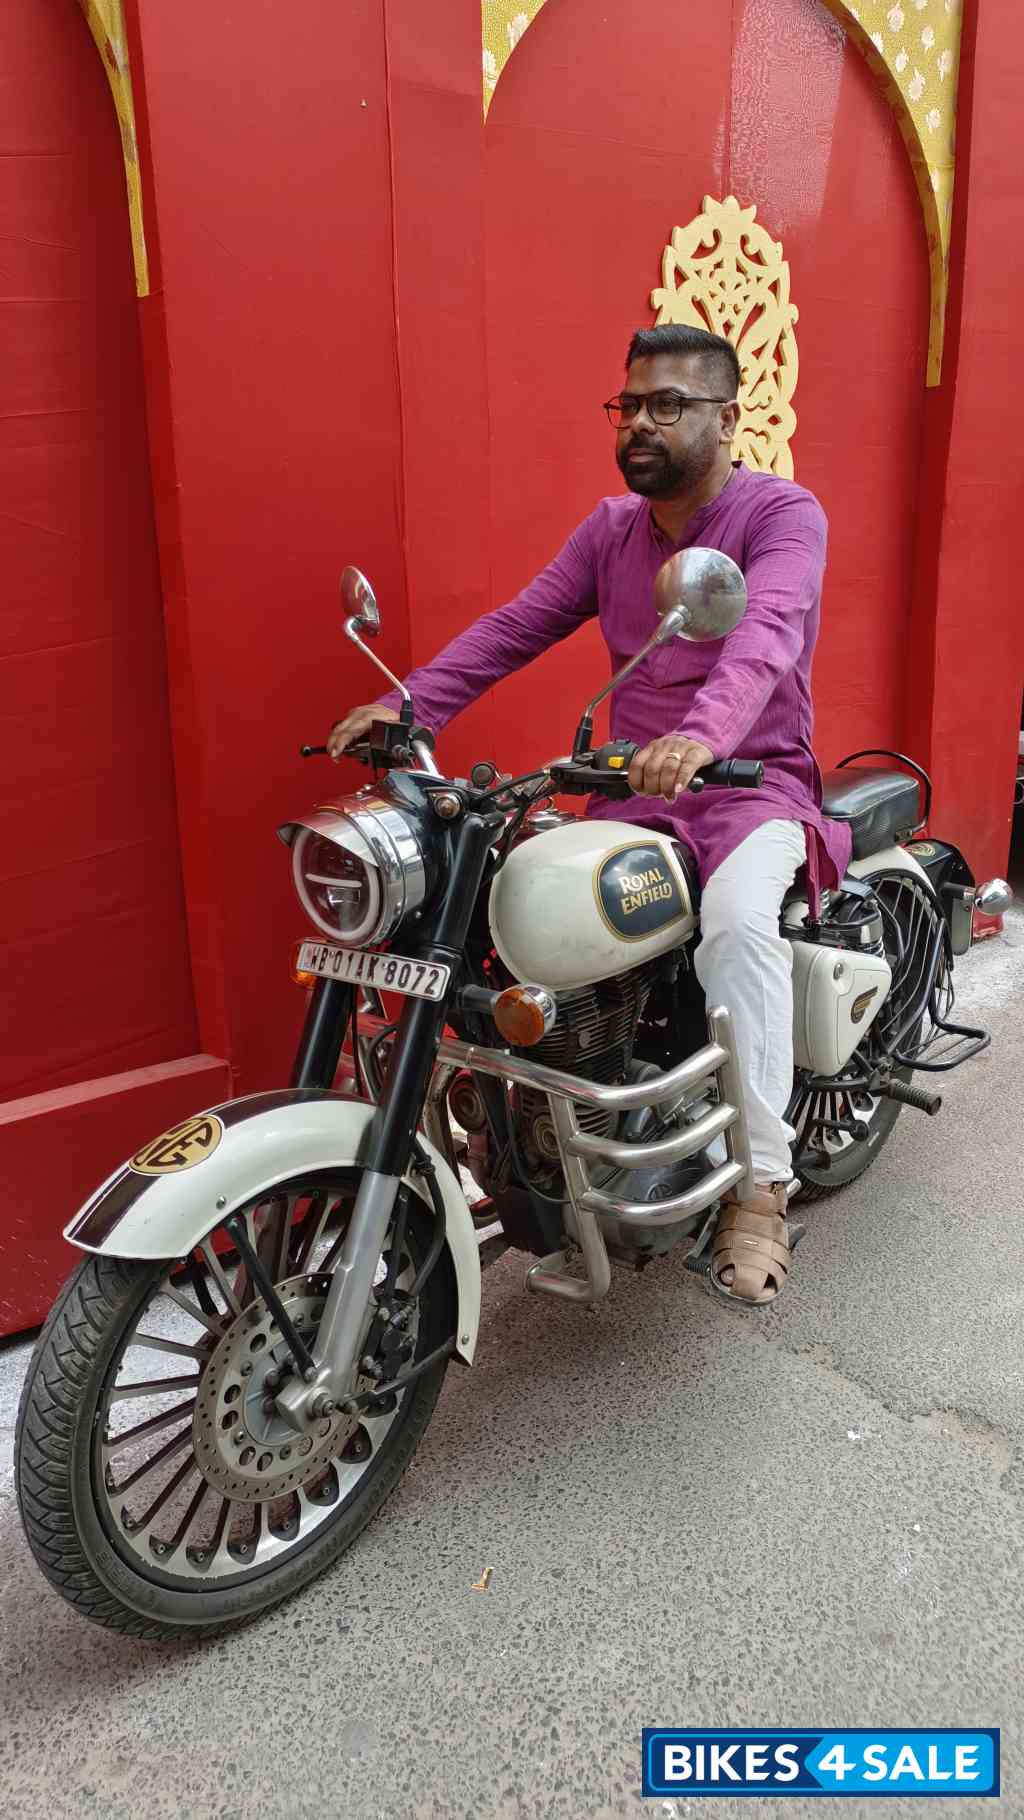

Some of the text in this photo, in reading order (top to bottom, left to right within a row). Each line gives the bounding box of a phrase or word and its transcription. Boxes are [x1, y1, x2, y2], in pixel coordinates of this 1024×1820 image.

[618, 867, 665, 895] ROYAL
[620, 882, 672, 915] ENFIELD
[383, 960, 440, 995] 8072
